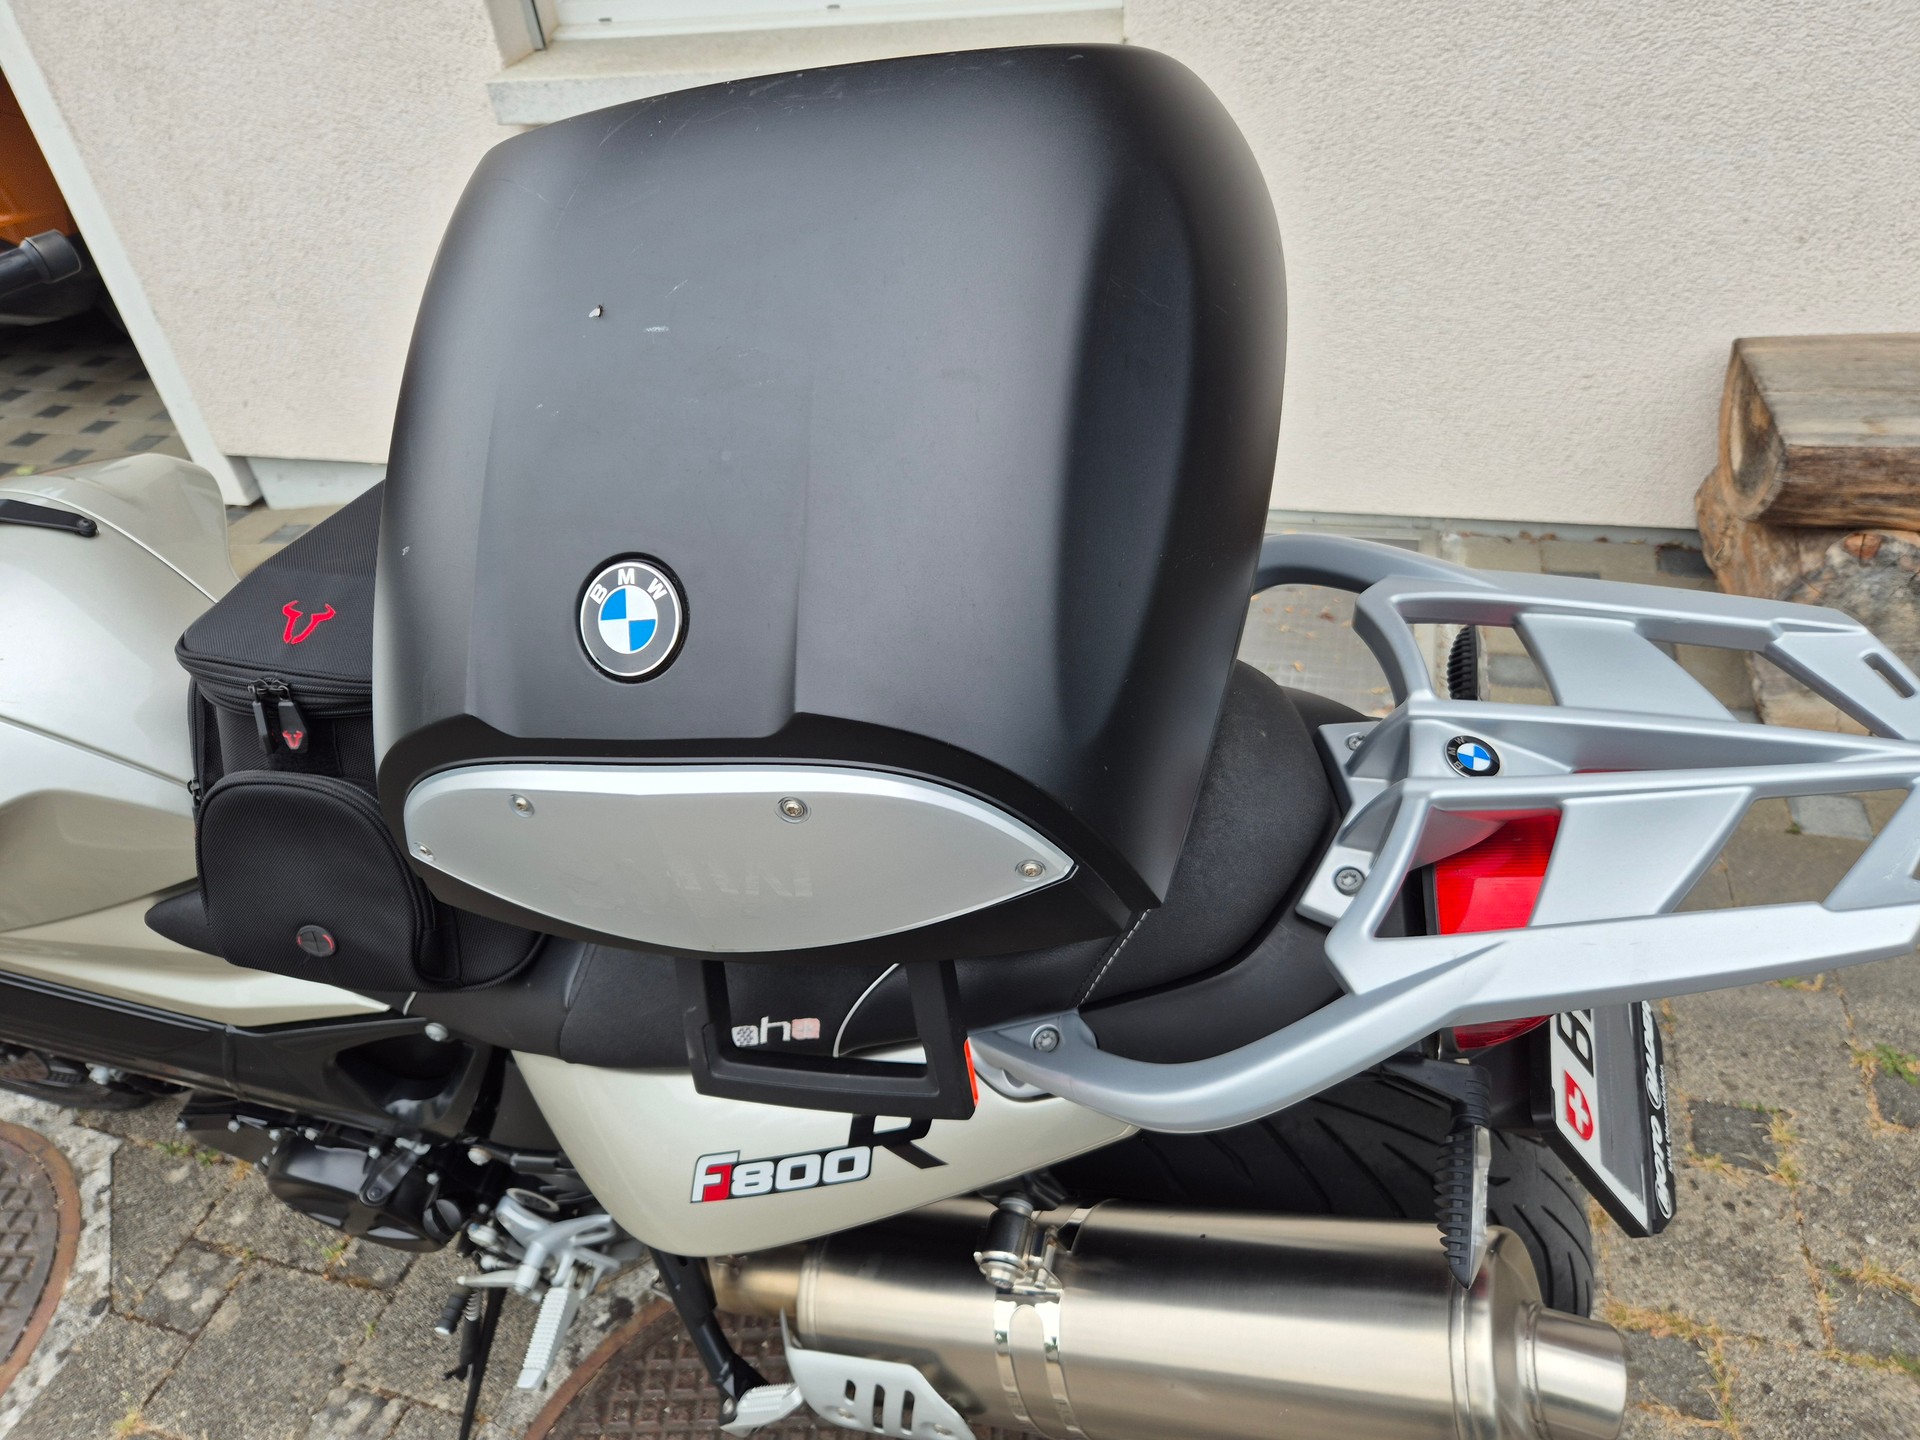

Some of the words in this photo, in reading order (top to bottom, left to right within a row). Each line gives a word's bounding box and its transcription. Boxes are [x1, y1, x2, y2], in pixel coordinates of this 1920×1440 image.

[589, 567, 668, 605] BMW
[1447, 736, 1466, 770] BMW
[1556, 1008, 1595, 1078] B
[1650, 1115, 1672, 1220] MOTO
